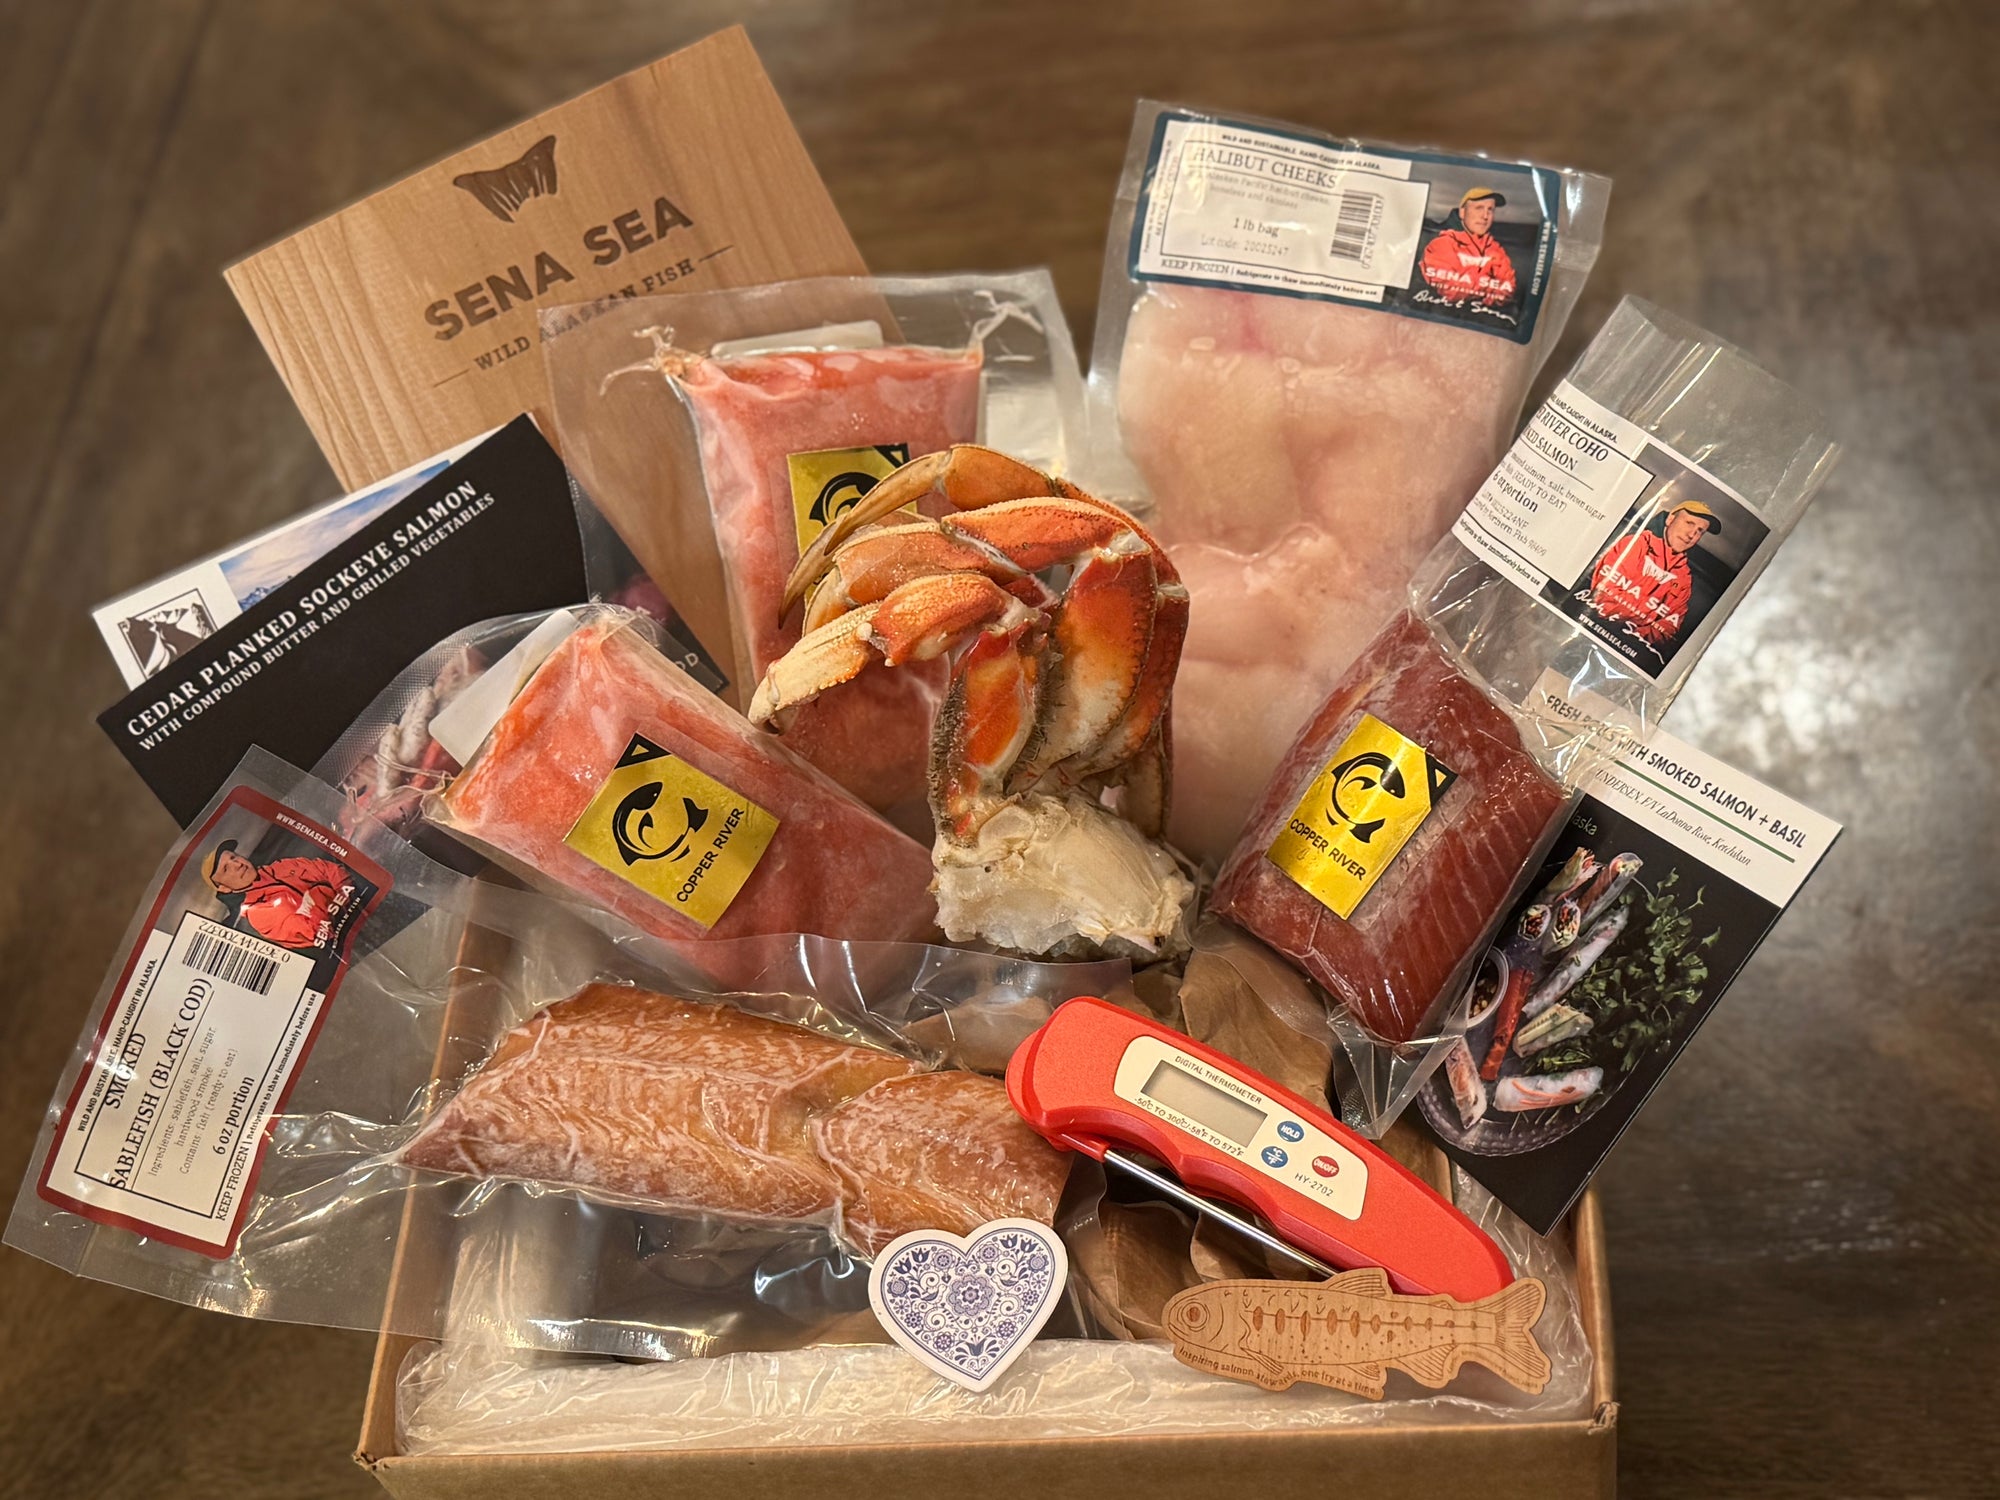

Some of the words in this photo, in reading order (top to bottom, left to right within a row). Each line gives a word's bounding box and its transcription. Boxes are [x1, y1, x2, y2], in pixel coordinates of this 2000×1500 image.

[1192, 147, 1267, 174] HALIBUT
[1270, 161, 1337, 189] CHEEKS
[1233, 217, 1239, 228] 1
[1243, 219, 1255, 231] lb
[1257, 222, 1279, 237] bag
[424, 251, 575, 341] SENA
[583, 196, 693, 265] SEA
[1161, 258, 1188, 269] KEEP
[1190, 261, 1229, 275] FROZEN
[1425, 266, 1472, 284] SENA
[1478, 275, 1514, 292] SEA
[474, 336, 531, 372] WILD
[539, 284, 638, 341] ALASKAN
[642, 259, 696, 292] FISH
[1535, 436, 1578, 470] SALMON
[1539, 411, 1571, 439] RIVER
[1567, 430, 1609, 463] COHO
[1491, 471, 1501, 482] 6
[1500, 480, 1541, 513] portion
[1535, 486, 1548, 499] TO
[1546, 494, 1568, 513] EAT)
[124, 677, 201, 739] CEDAR
[197, 606, 300, 687] PLANKED
[297, 540, 394, 616] SOCKEYE
[390, 478, 479, 550] SALMON
[1598, 563, 1643, 598] SENA
[1644, 595, 1682, 627] SEA
[137, 715, 184, 753] WITH
[179, 658, 264, 723] COMPOUND
[260, 617, 322, 666] BUTTER
[318, 594, 353, 625] AND
[349, 551, 412, 602] GRILLED
[409, 490, 497, 559] VEGETABLES
[1577, 614, 1638, 657] WWW.SENASEA.COM
[1544, 694, 1582, 722] FRESH
[1614, 734, 1648, 761] WITH
[1646, 751, 1702, 789] SMOKED
[1699, 780, 1757, 821] SALMON
[1757, 813, 1770, 826] +
[1768, 818, 1807, 848] BASIL
[275, 813, 348, 857] WWW.SENASEA.COM
[1655, 803, 1694, 832] LaDonna
[677, 851, 718, 902] COPPER
[712, 808, 744, 849] RIVER
[1290, 818, 1329, 852] COPPER
[1329, 850, 1366, 880] RIVER
[312, 918, 332, 948] SENA
[326, 881, 354, 916] SEA
[138, 957, 157, 988] ALASKA.
[280, 951, 291, 963] 0
[134, 988, 143, 996] IN
[306, 992, 317, 1007] use
[112, 996, 140, 1048] HAND-CAUGHT
[295, 1006, 310, 1029] before
[103, 1031, 147, 1109] SMOKED
[221, 1045, 239, 1068] eat)
[274, 1029, 301, 1074] immediately
[107, 1091, 160, 1189] SABLEFISH
[147, 1023, 190, 1091] (BLACK
[176, 975, 212, 1023] COD)
[217, 1067, 229, 1079] to
[266, 1073, 280, 1092] thaw
[1175, 1055, 1204, 1074] DIGITAL
[1204, 1071, 1263, 1104] THERMOMETER
[85, 1096, 97, 1113] AND
[173, 1098, 201, 1147] hardwood
[193, 1065, 214, 1098] smoke
[202, 1078, 225, 1112] (ready
[223, 1074, 257, 1127] portion
[263, 1092, 271, 1100] to
[77, 1113, 90, 1132] WILD
[147, 1120, 177, 1176] Ingredients:
[168, 1072, 196, 1121] sablefish,
[194, 1110, 211, 1131] fish
[218, 1127, 233, 1145] oz
[1154, 1107, 1166, 1117] TO
[1209, 1135, 1222, 1147] TO
[1280, 1125, 1301, 1139] HOLD
[212, 1144, 226, 1155] 6
[226, 1145, 249, 1190] FROZEN
[1294, 1173, 1335, 1197] HY-2702
[215, 1190, 232, 1220] KEEP
[1180, 1346, 1219, 1370] Inspiring
[1221, 1364, 1254, 1376] salmon
[1301, 1370, 1319, 1378] one
[1321, 1370, 1335, 1383] fry
